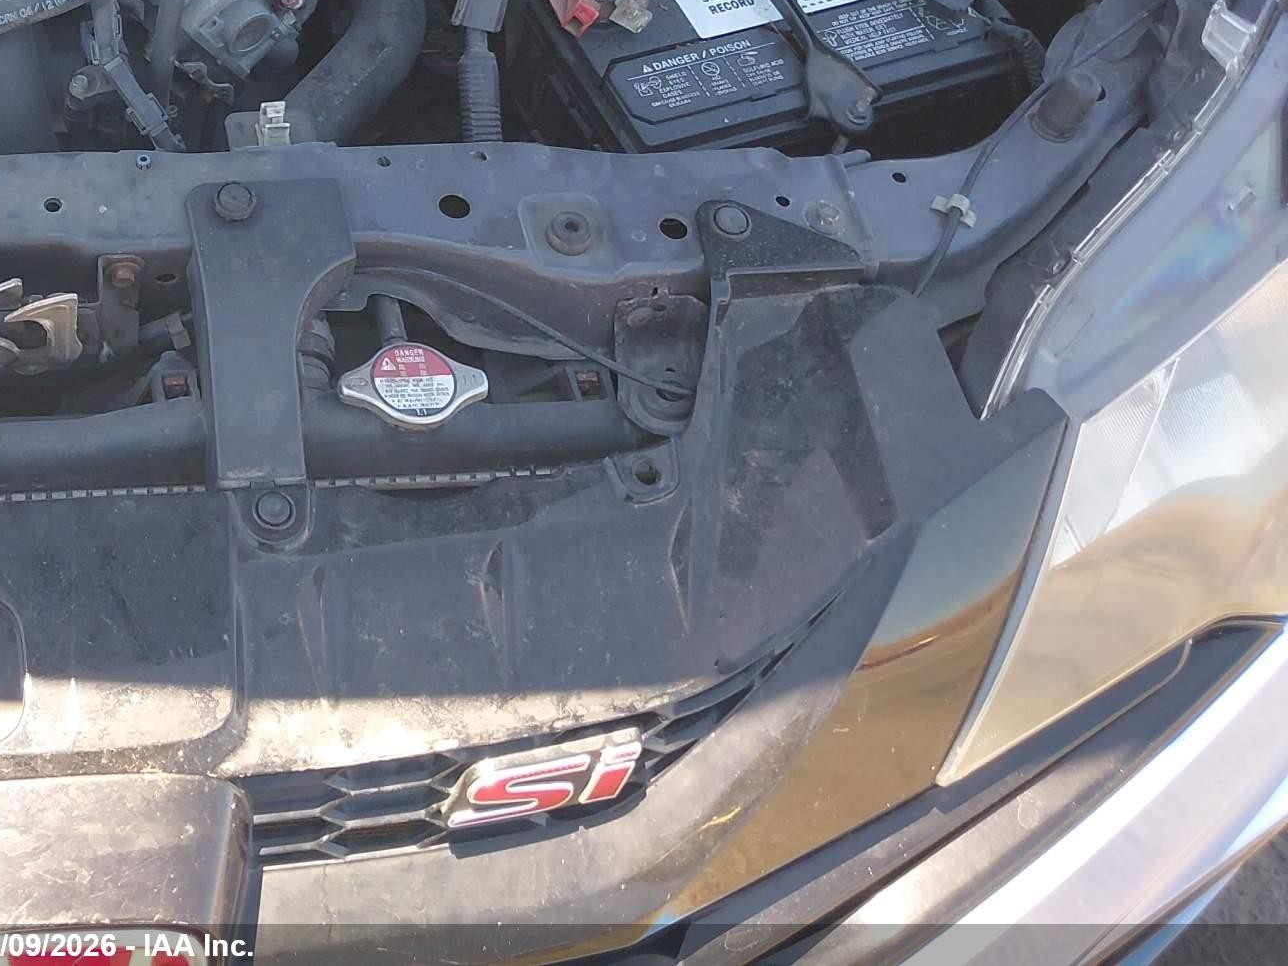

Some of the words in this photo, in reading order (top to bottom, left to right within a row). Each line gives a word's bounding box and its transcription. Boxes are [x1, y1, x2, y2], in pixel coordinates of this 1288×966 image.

[652, 52, 699, 71] DANGER
[709, 39, 752, 56] POISON
[447, 737, 643, 828] Si
